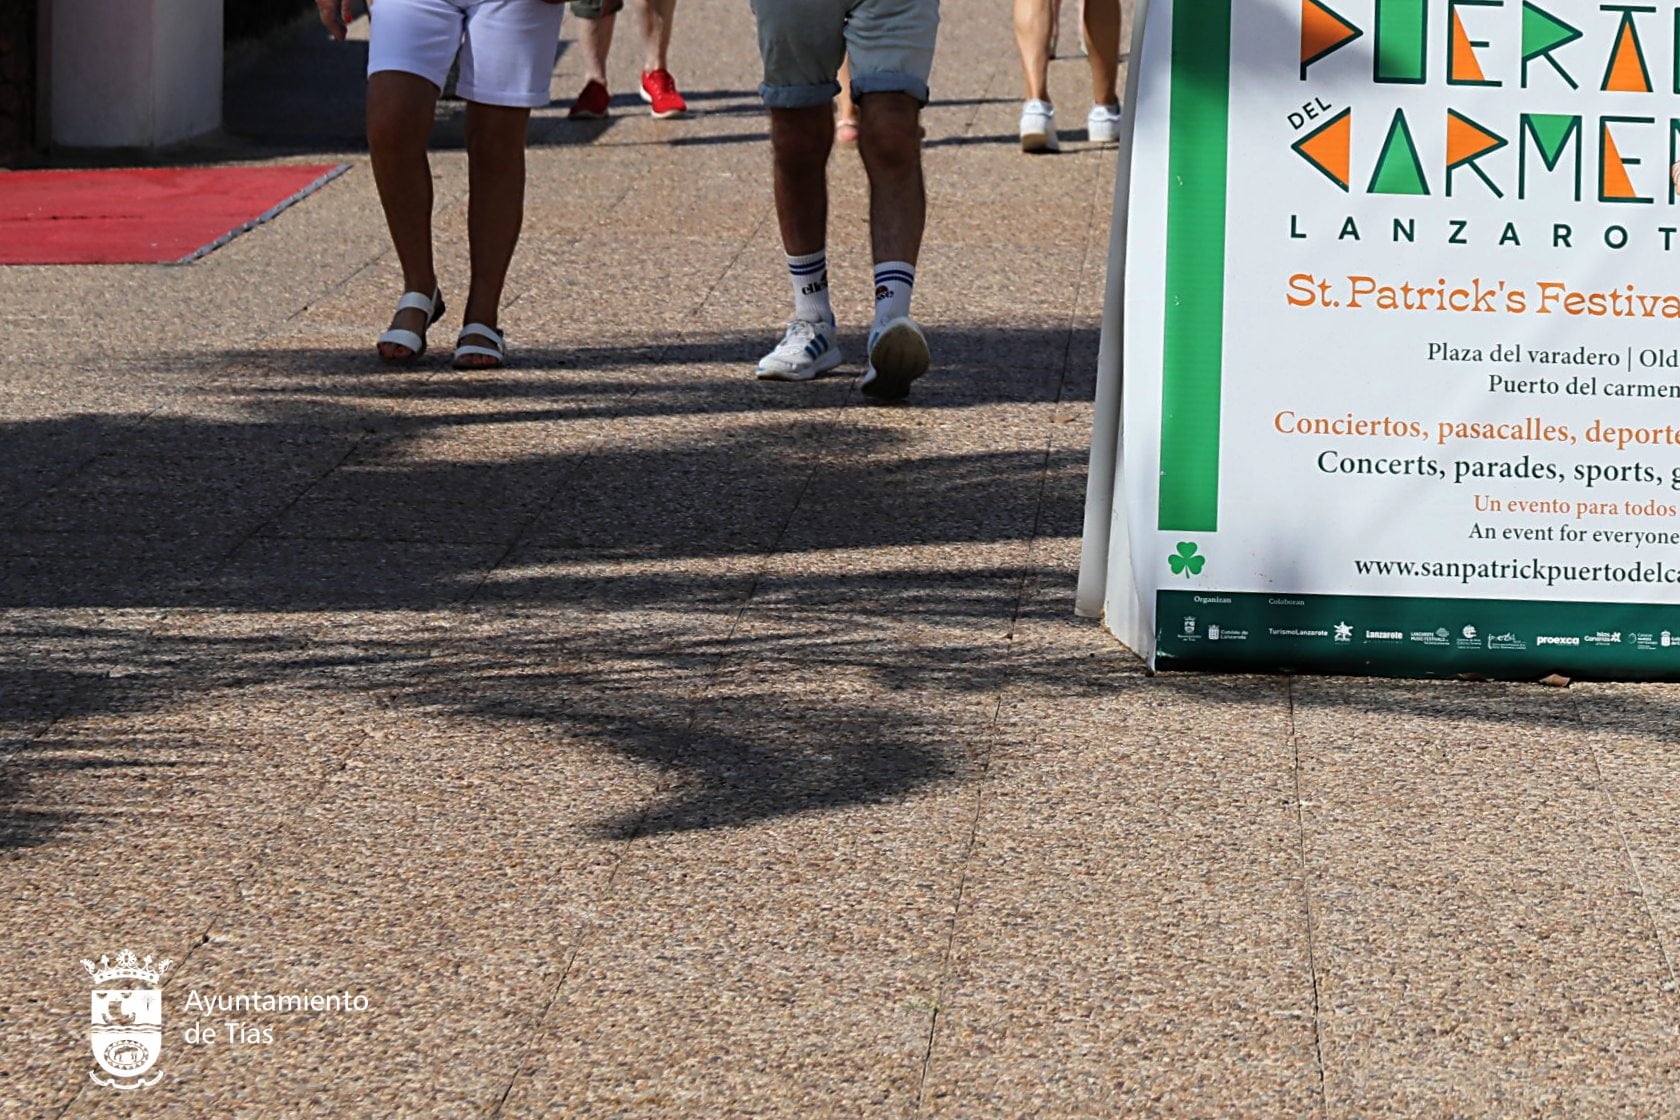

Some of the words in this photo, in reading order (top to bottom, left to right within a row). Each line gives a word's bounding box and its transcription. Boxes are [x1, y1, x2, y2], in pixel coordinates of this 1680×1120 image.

[1287, 96, 1333, 131] DEL
[1427, 342, 1483, 363] Plaza
[1489, 343, 1521, 364] del
[1527, 346, 1621, 368] varadero
[1638, 348, 1679, 370] Old
[1487, 374, 1560, 396] Puerto
[1565, 377, 1597, 397] del
[1273, 410, 1430, 441] Conciertos,
[1436, 416, 1577, 445] pasacalles,
[1317, 450, 1446, 480] Concerts,
[1453, 455, 1566, 484] parades,
[1573, 461, 1663, 488] sports,
[1473, 495, 1502, 513] Un
[1506, 497, 1571, 515] evento
[1575, 501, 1619, 520] para
[1623, 499, 1677, 517] todos
[1468, 523, 1496, 540] An
[1502, 526, 1554, 541] event
[1559, 524, 1588, 542] for
[1592, 530, 1680, 549] everyone
[1193, 595, 1232, 604] Organizan
[1268, 627, 1329, 637] TurismoLanzarote
[1365, 630, 1403, 640] Lanzarote
[1536, 635, 1580, 647] proexca
